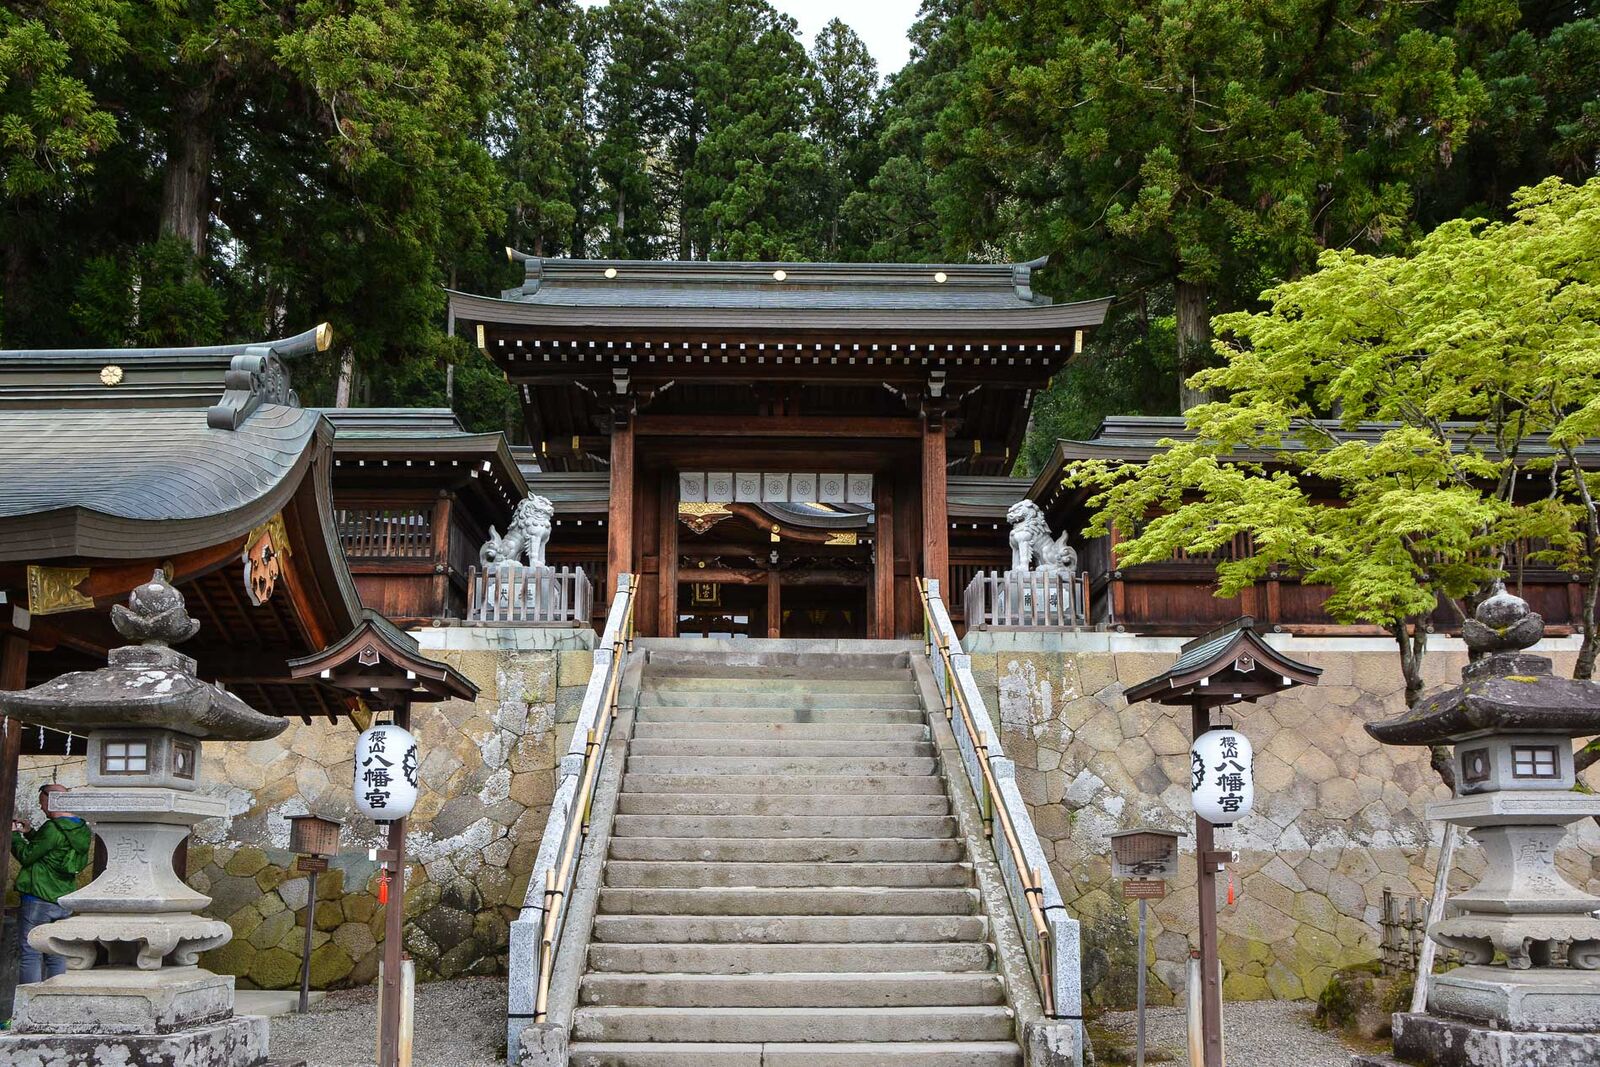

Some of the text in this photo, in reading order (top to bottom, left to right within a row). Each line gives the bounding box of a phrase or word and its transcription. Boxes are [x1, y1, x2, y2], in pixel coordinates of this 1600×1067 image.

[362, 730, 394, 809] 櫻山八幡宮
[1214, 736, 1246, 812] 櫻山八幡宮
